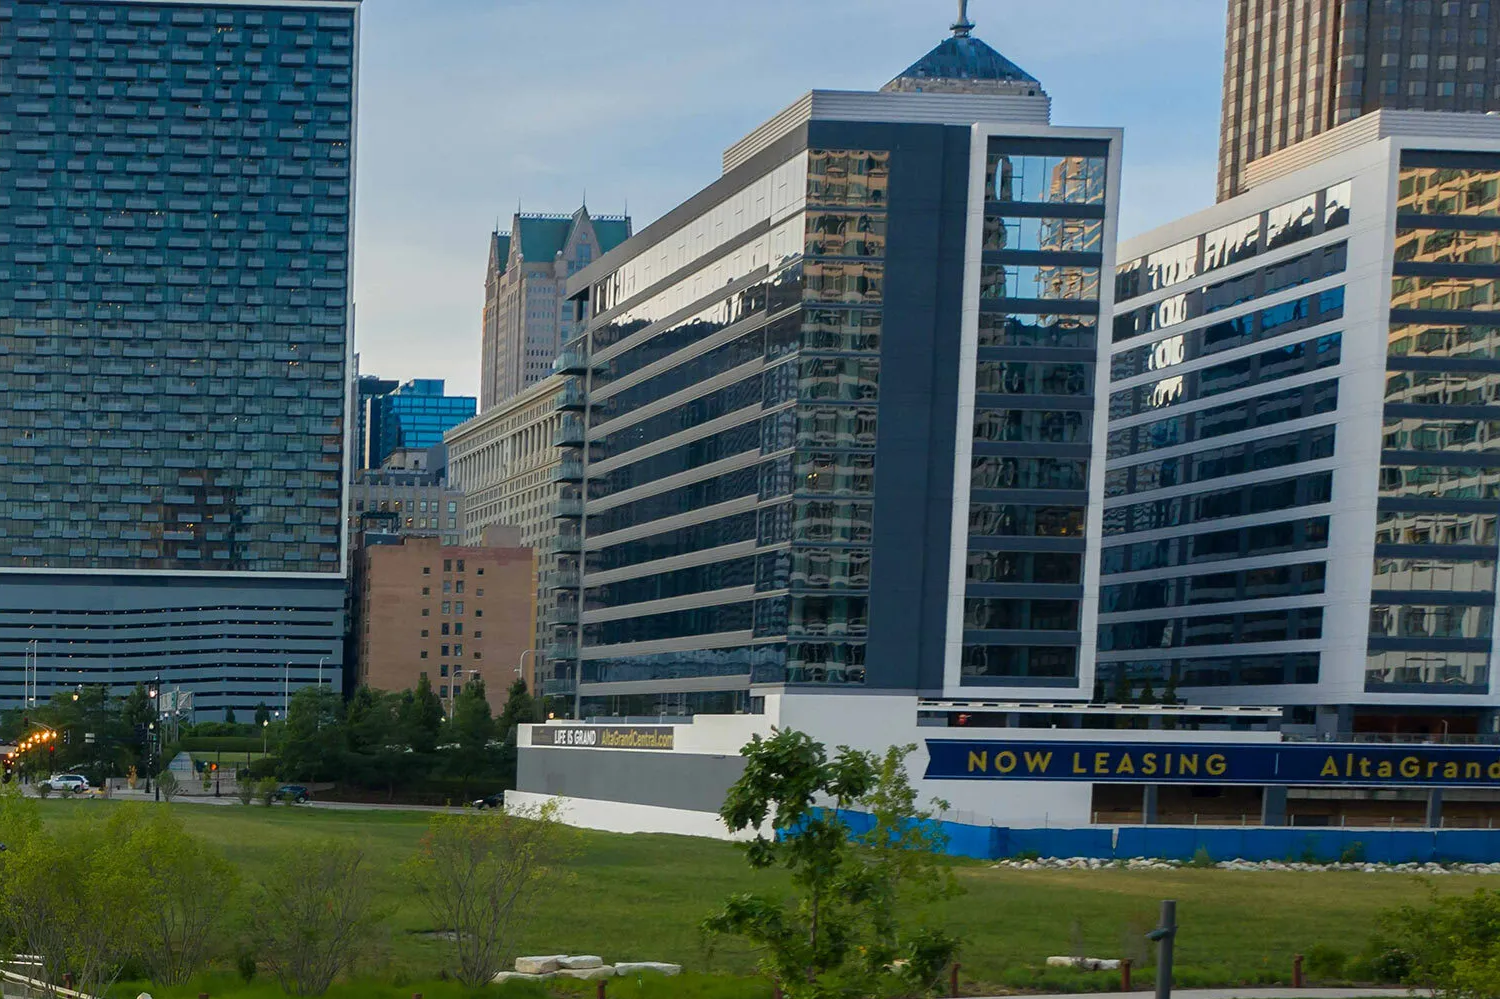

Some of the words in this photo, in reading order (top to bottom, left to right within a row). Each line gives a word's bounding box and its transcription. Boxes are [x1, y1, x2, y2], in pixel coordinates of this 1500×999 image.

[554, 729, 566, 744] LIFE
[567, 729, 574, 744] IS
[574, 729, 597, 745] GRAND
[601, 728, 674, 747] AltaGrandCentral.com
[967, 750, 1053, 773] NOW
[1072, 752, 1228, 775] LEASING
